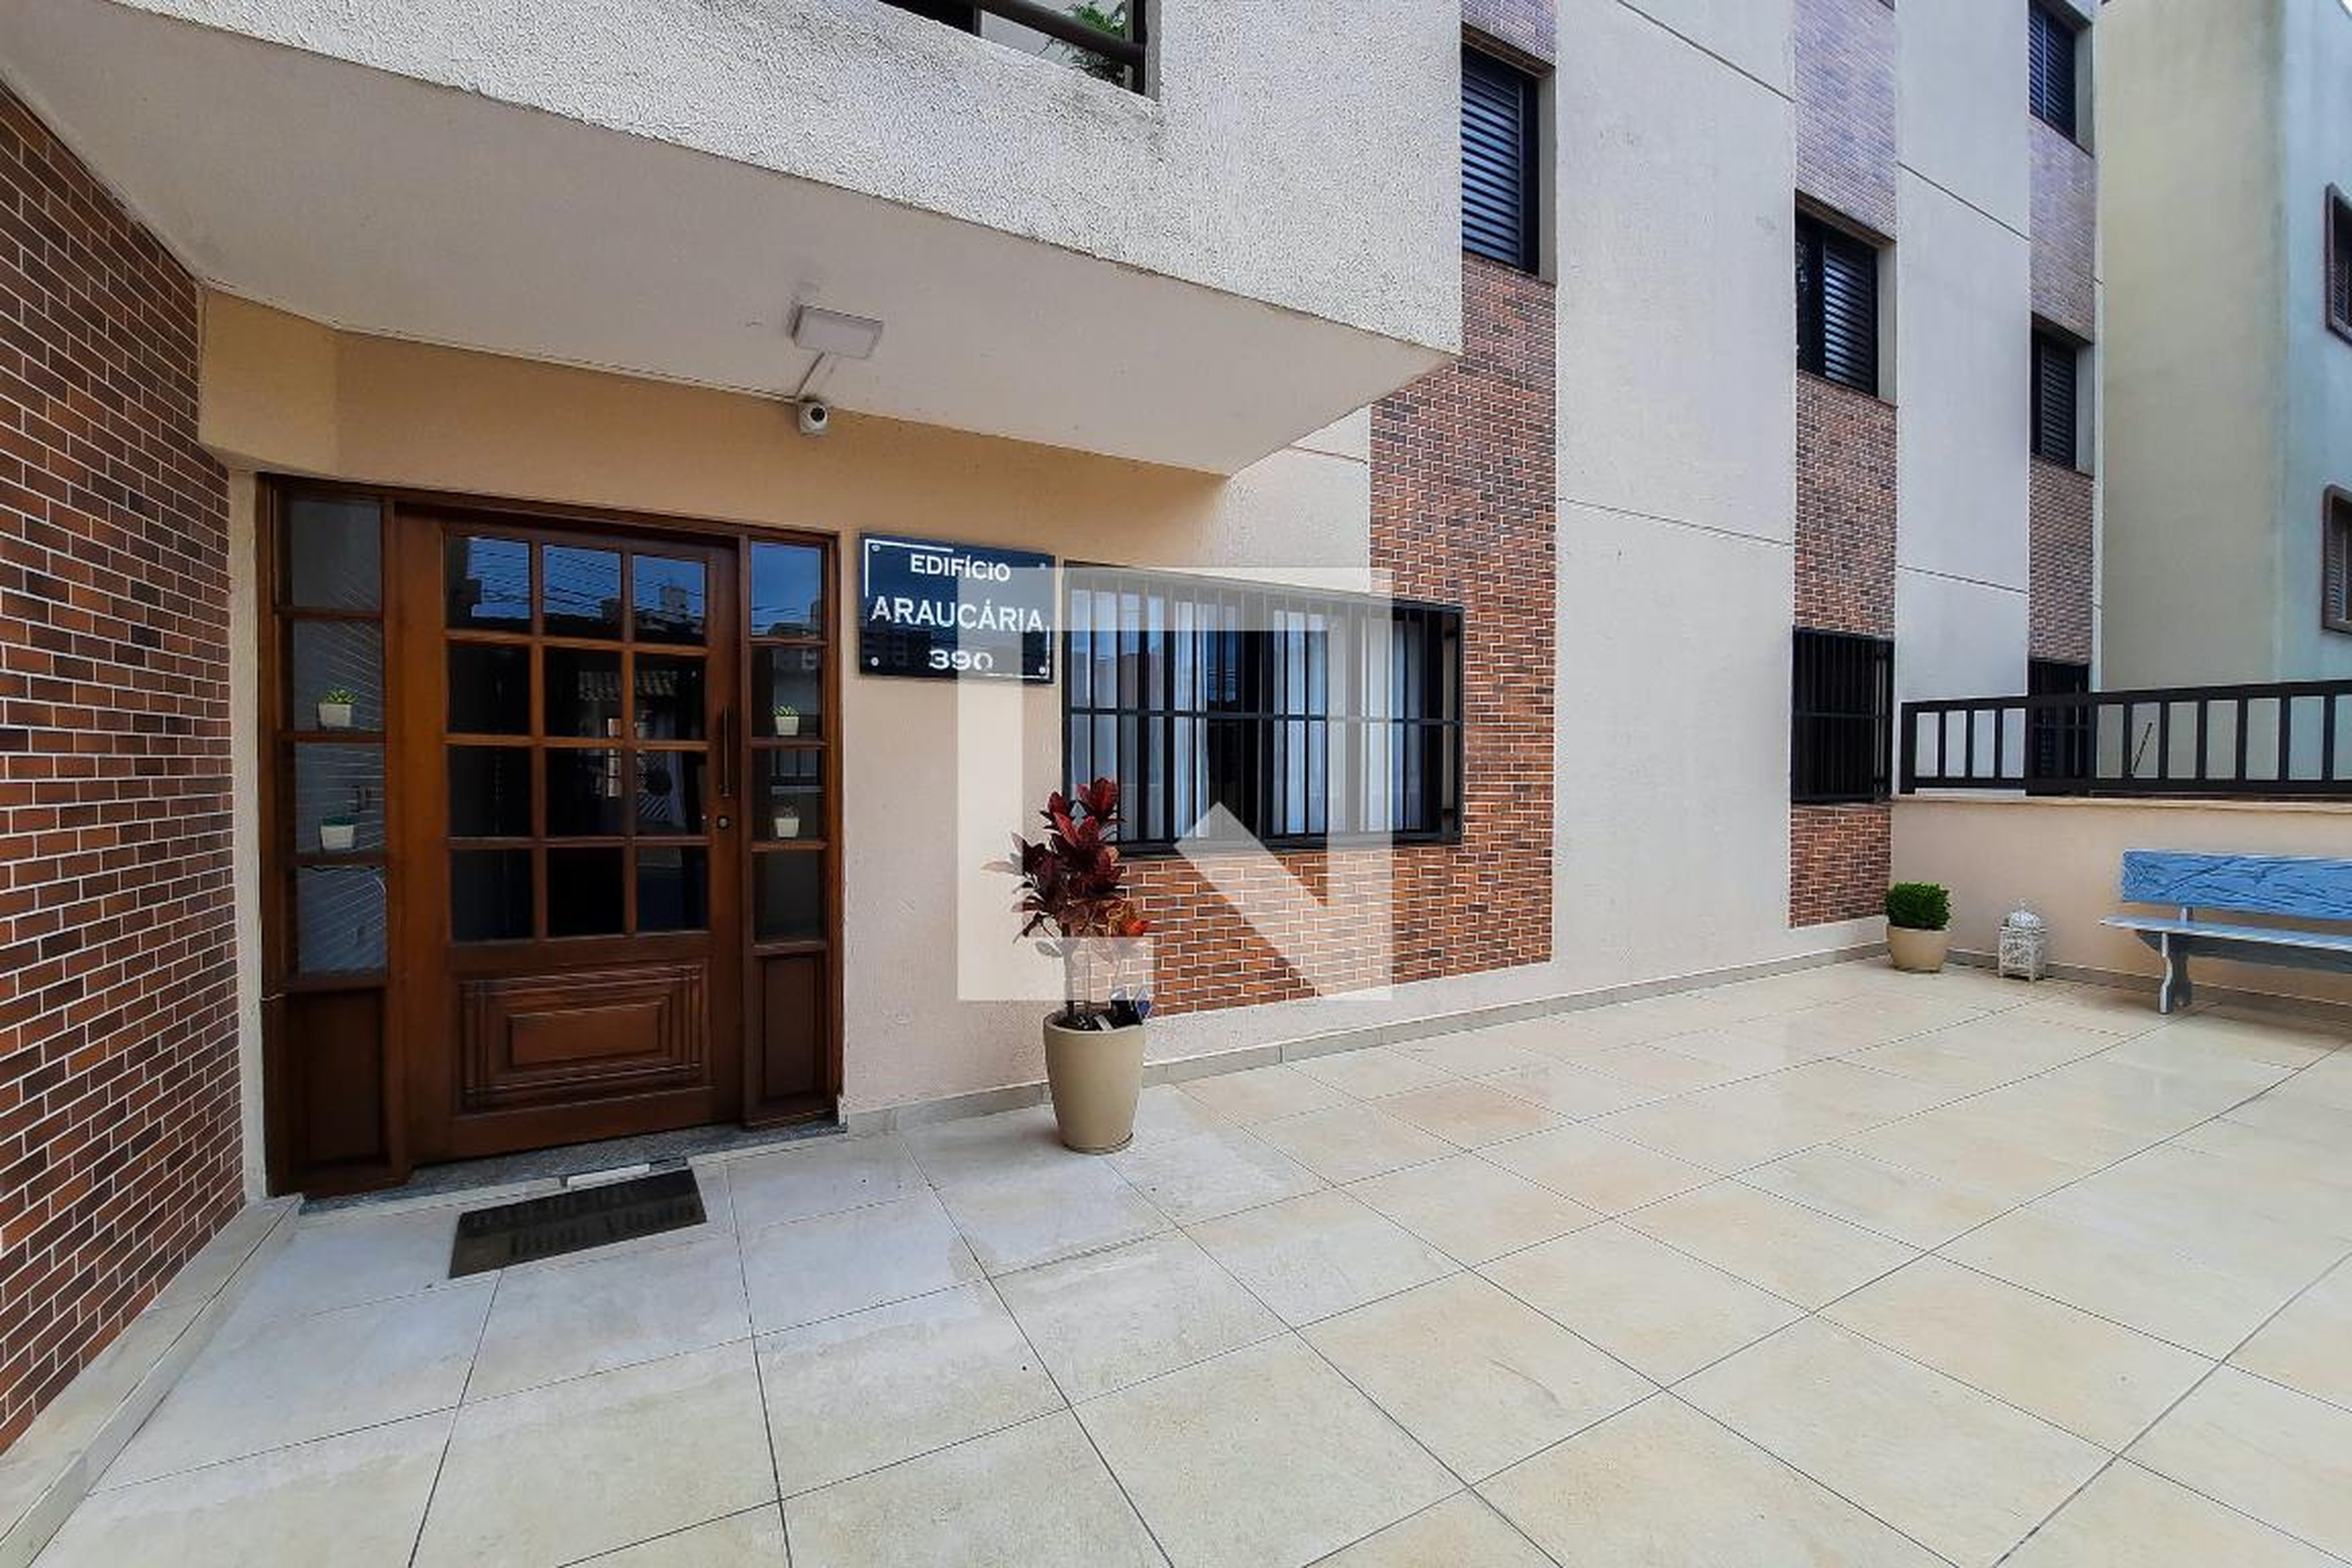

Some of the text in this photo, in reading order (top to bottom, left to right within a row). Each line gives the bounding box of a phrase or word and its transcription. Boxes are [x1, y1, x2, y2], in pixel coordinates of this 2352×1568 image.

[910, 553, 1011, 581] EDIFÍCIO
[869, 595, 1044, 632] ARAUCÁRIA
[929, 648, 993, 671] 390
